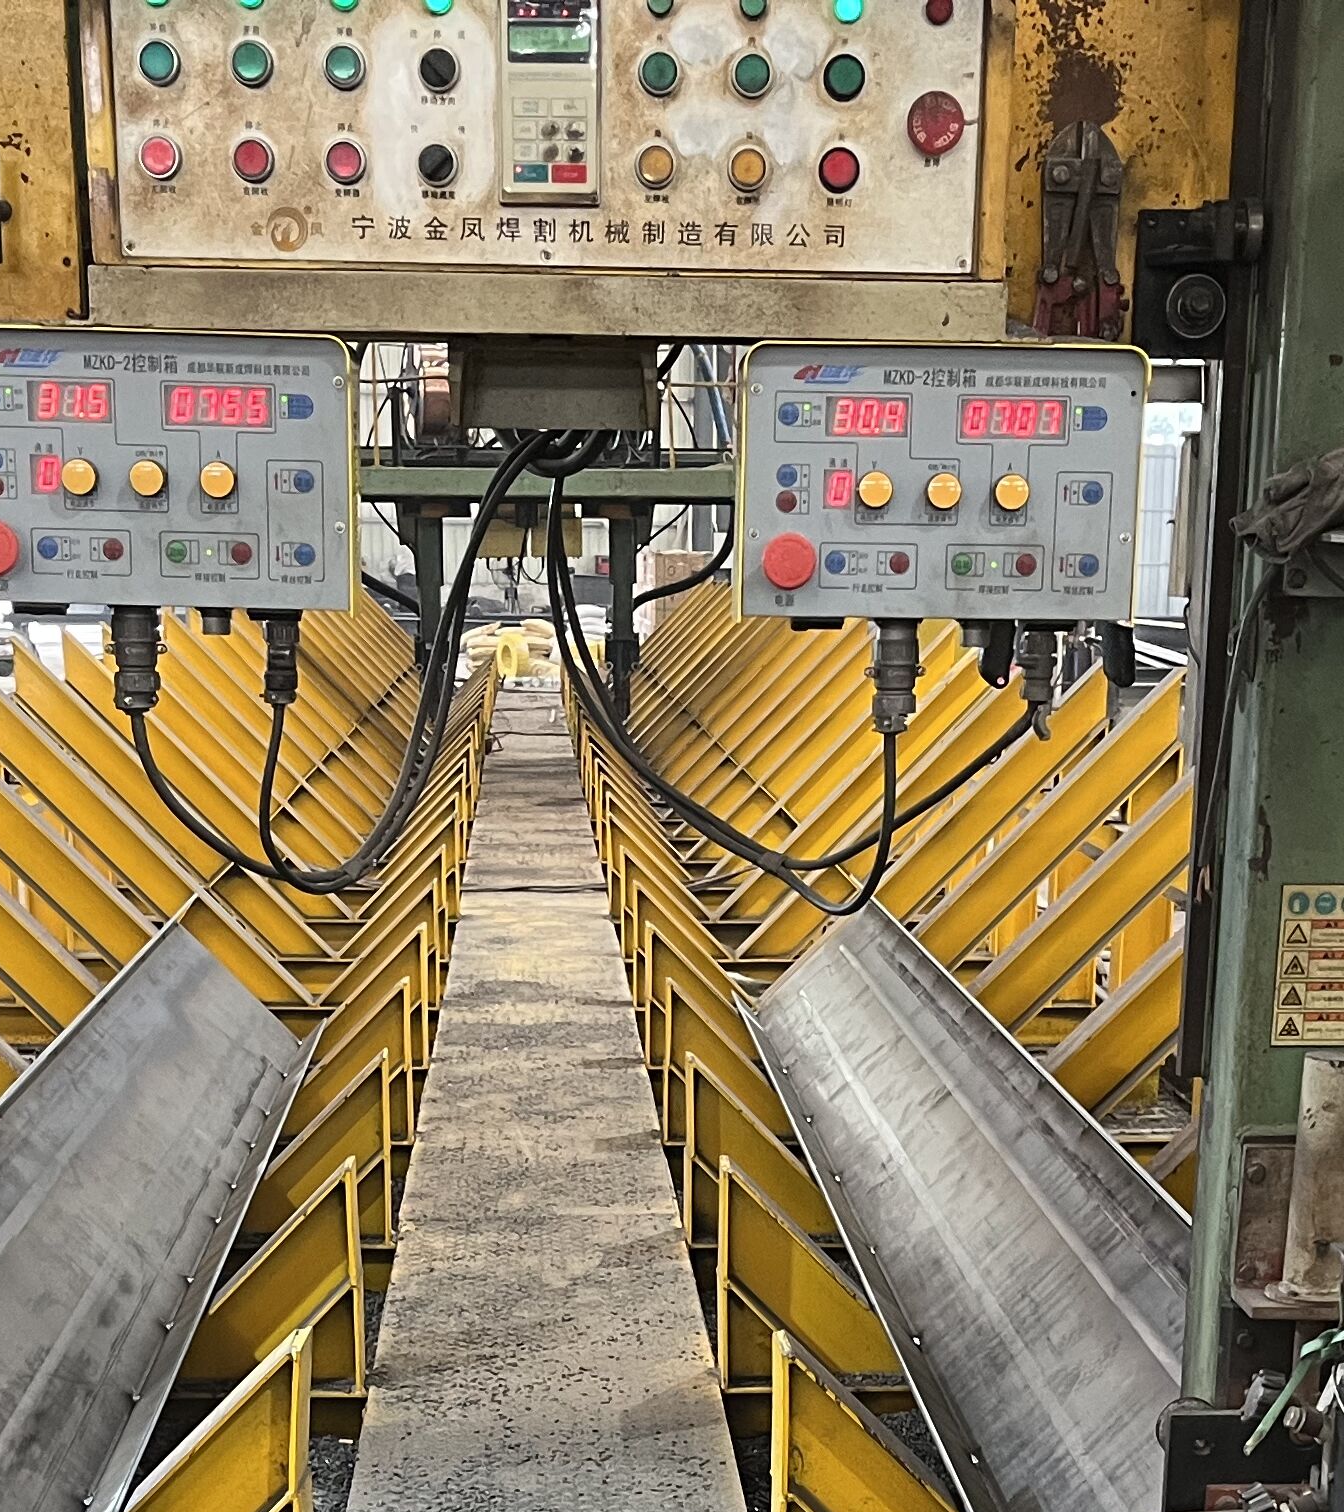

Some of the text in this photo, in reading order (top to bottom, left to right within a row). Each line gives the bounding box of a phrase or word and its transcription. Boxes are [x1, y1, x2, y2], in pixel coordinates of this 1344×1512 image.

[351, 214, 848, 249] 宁波金凤焊割机械制造有限公司
[83, 353, 178, 374] MZKD-2控制箱
[883, 367, 976, 389] MZKD-2控制箱
[37, 382, 269, 425] 31.5 0755
[962, 400, 1063, 439] 0707
[37, 457, 62, 492] 0
[826, 470, 853, 508] 0
